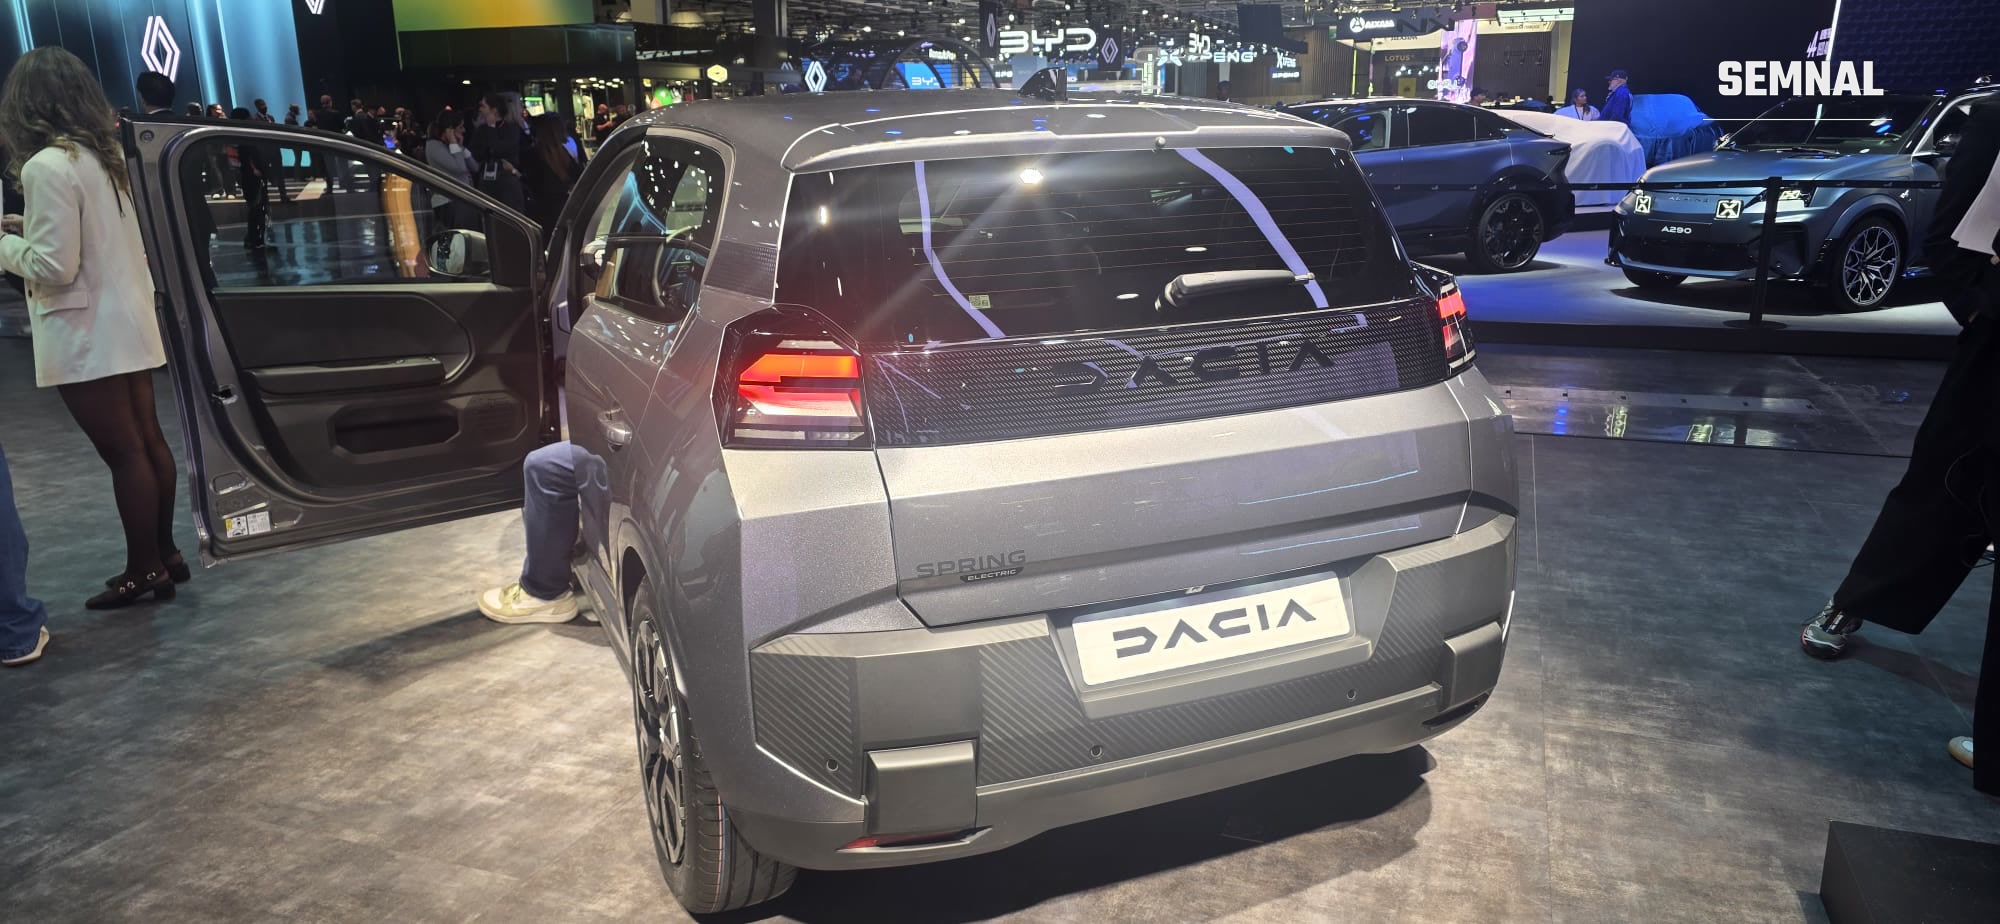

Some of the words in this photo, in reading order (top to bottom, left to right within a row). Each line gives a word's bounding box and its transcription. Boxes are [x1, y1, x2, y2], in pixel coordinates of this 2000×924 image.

[1000, 27, 1097, 54] BYD
[1188, 32, 1211, 54] BYD
[1661, 225, 1692, 235] A290
[1050, 340, 1335, 394] DACIA
[916, 549, 1026, 578] SPRING
[967, 568, 1017, 581] ELECTRIC
[1112, 598, 1317, 659] DACIA
